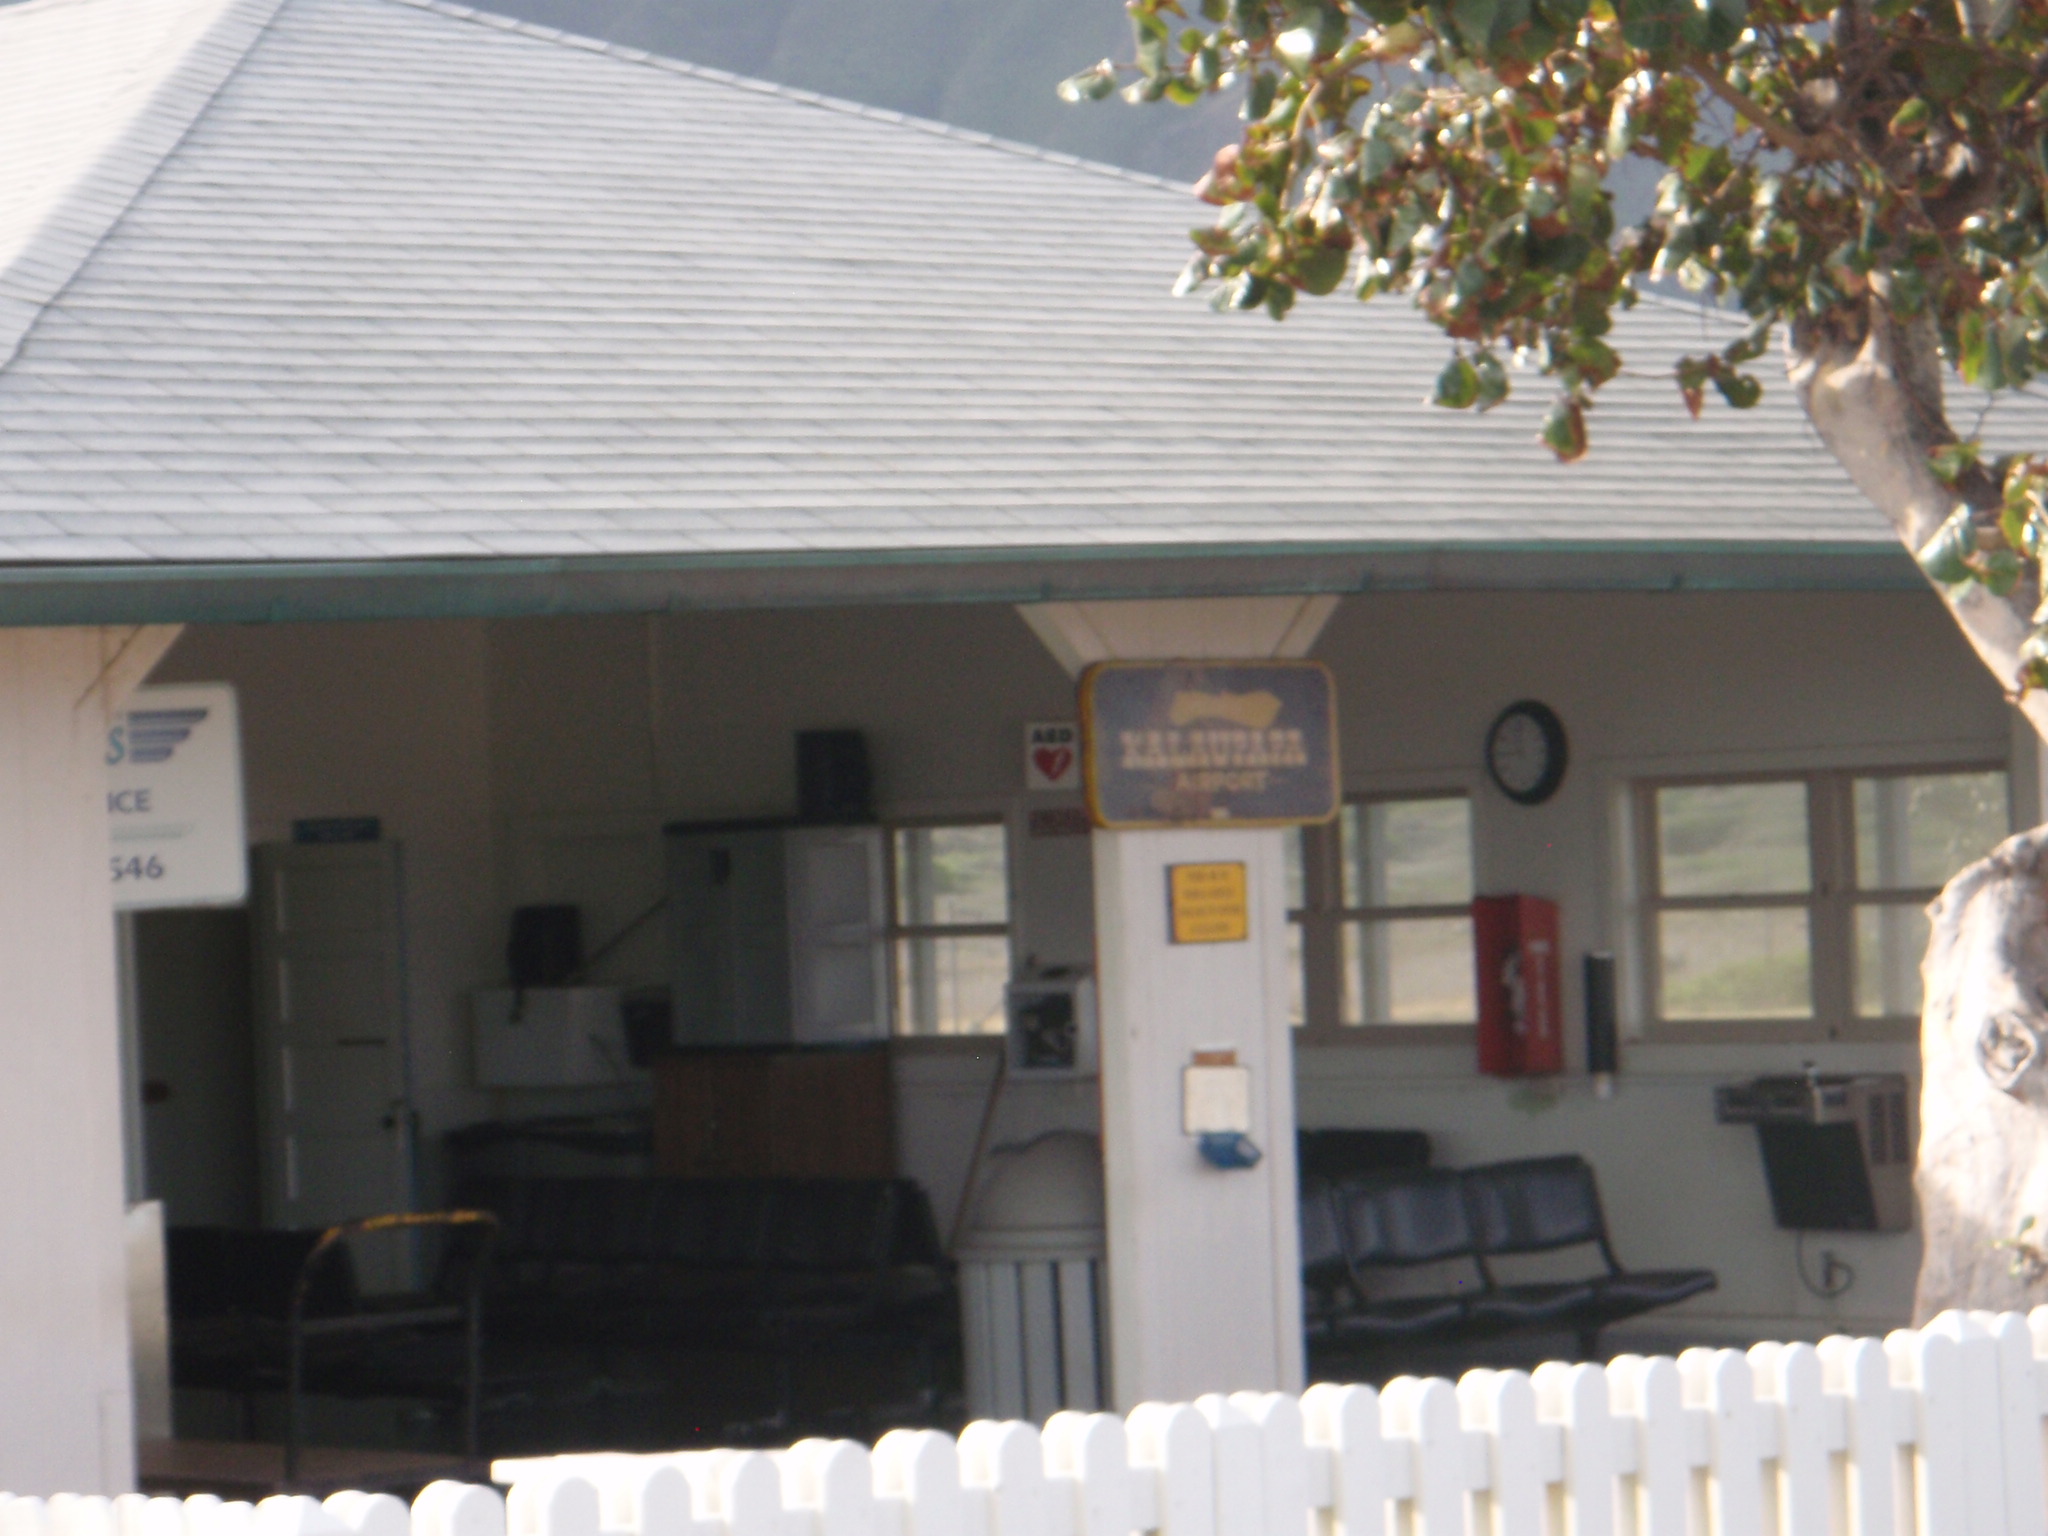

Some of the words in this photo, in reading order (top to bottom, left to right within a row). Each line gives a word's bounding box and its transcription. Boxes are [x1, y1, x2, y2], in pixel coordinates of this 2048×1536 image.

[1032, 728, 1073, 743] AED
[1119, 730, 1307, 770] KALAUPAPA
[1175, 770, 1268, 792] AIRPORT
